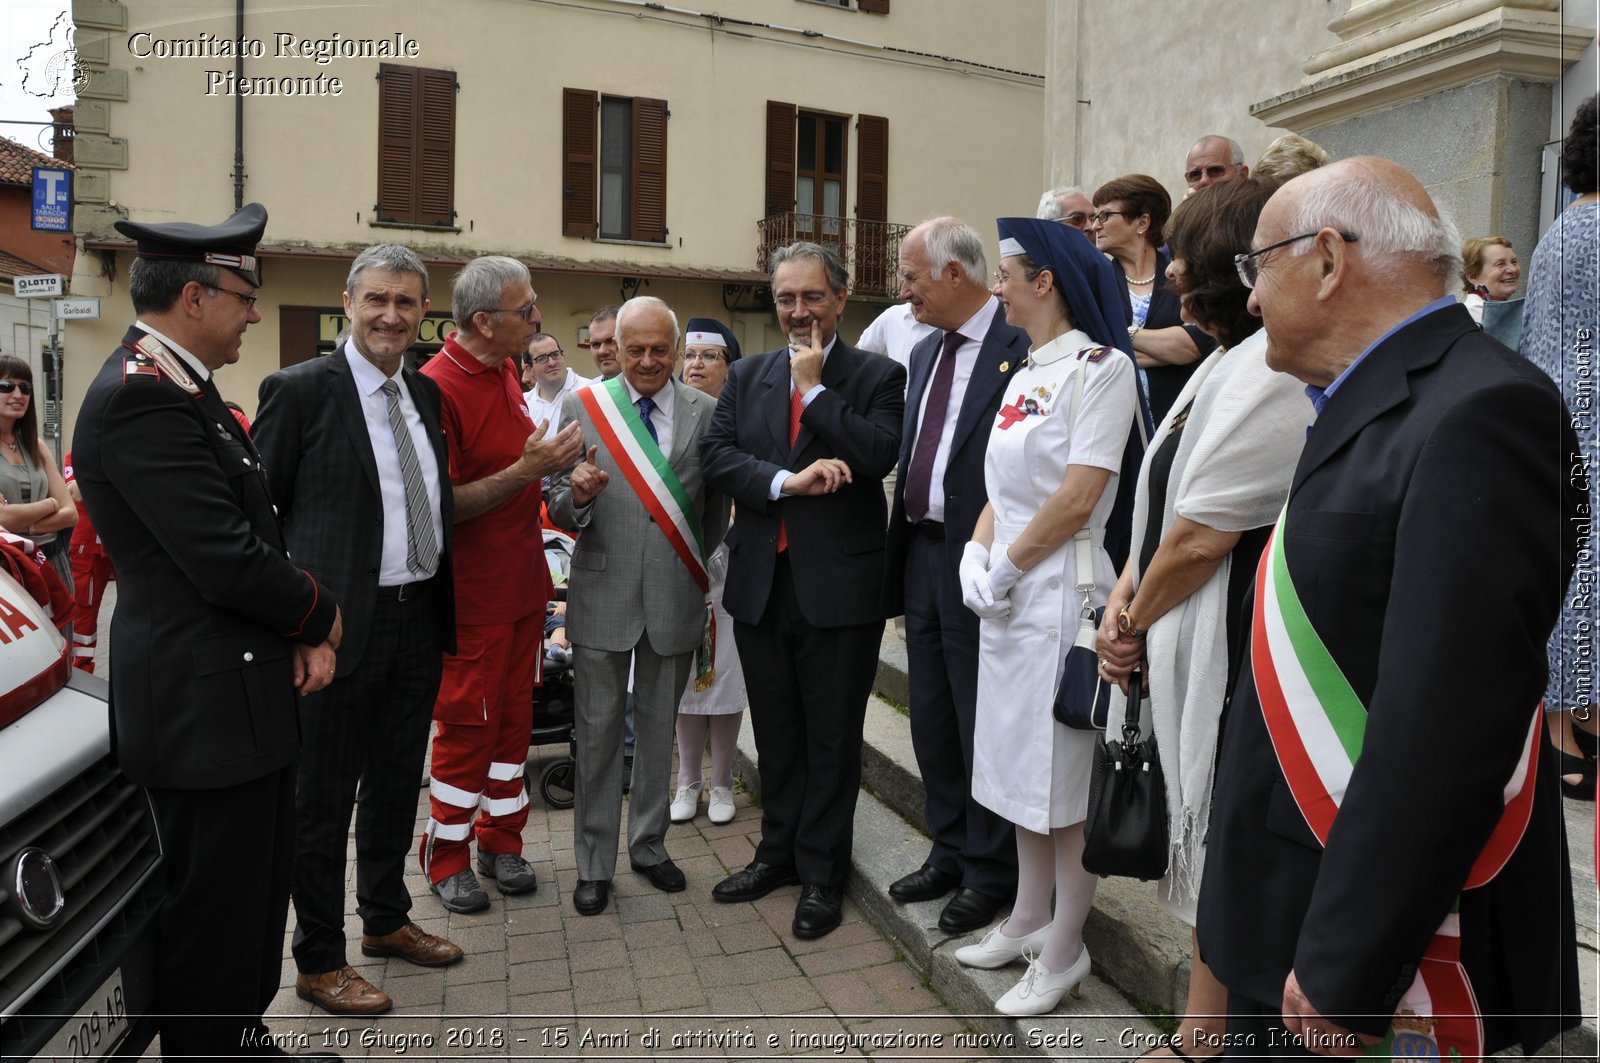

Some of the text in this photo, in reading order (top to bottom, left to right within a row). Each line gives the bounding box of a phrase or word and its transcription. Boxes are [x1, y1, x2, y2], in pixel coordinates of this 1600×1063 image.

[38, 170, 64, 205] T
[35, 222, 66, 230] GIORNALI
[28, 278, 57, 286] LOTTO
[63, 307, 92, 315] Garibaldi
